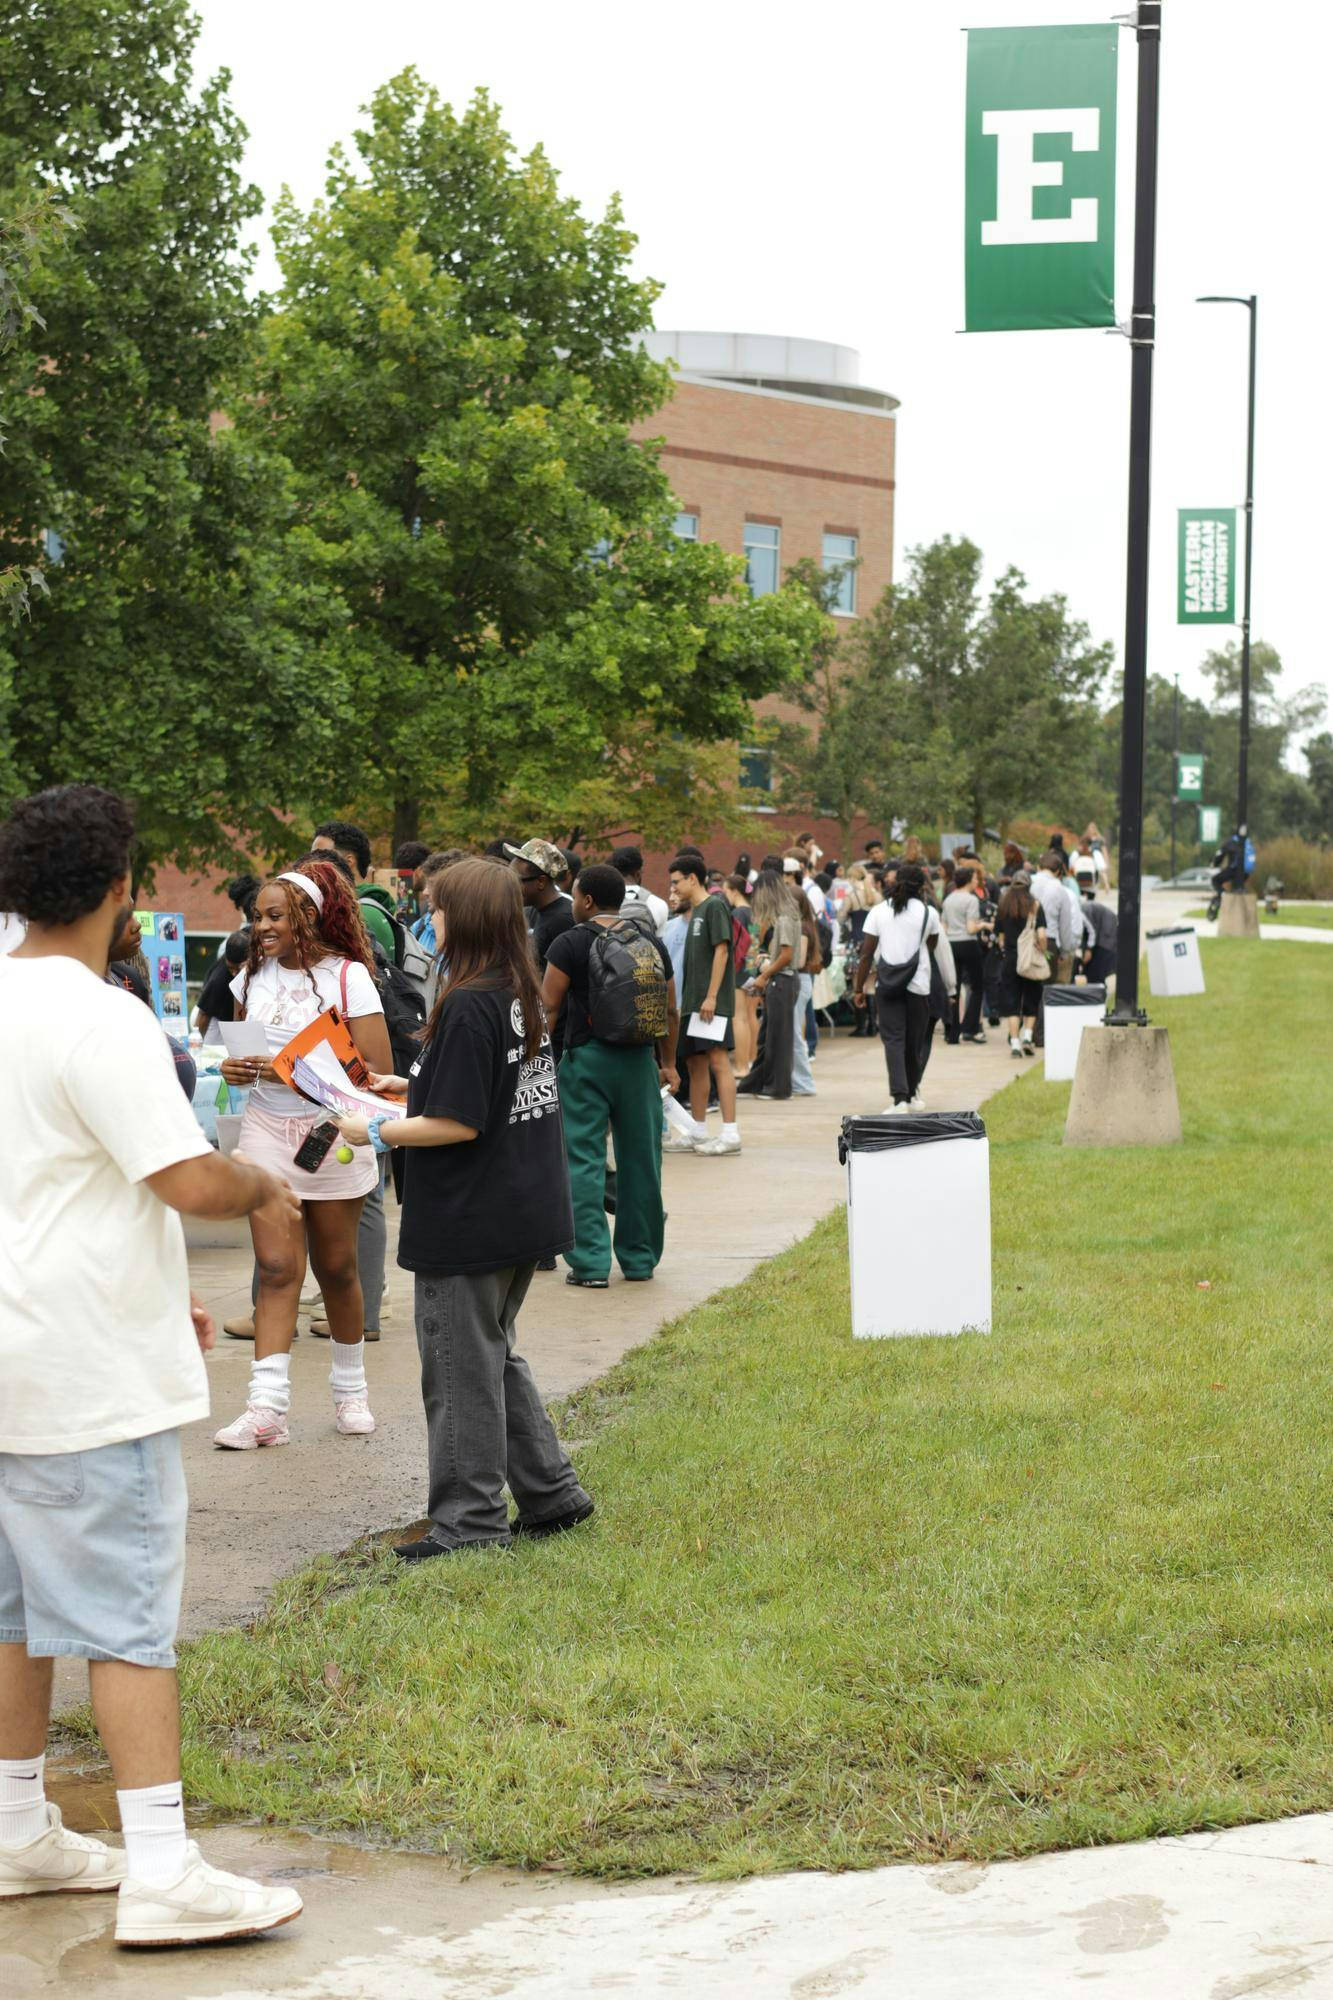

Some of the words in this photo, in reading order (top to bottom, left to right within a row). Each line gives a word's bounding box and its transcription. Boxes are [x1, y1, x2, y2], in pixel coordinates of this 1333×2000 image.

[981, 107, 1100, 246] E
[1185, 520, 1201, 613] EASTERN
[1201, 521, 1215, 613] MICHIGAN
[1215, 520, 1229, 613] UNIVERSITY
[1180, 766, 1201, 790] E
